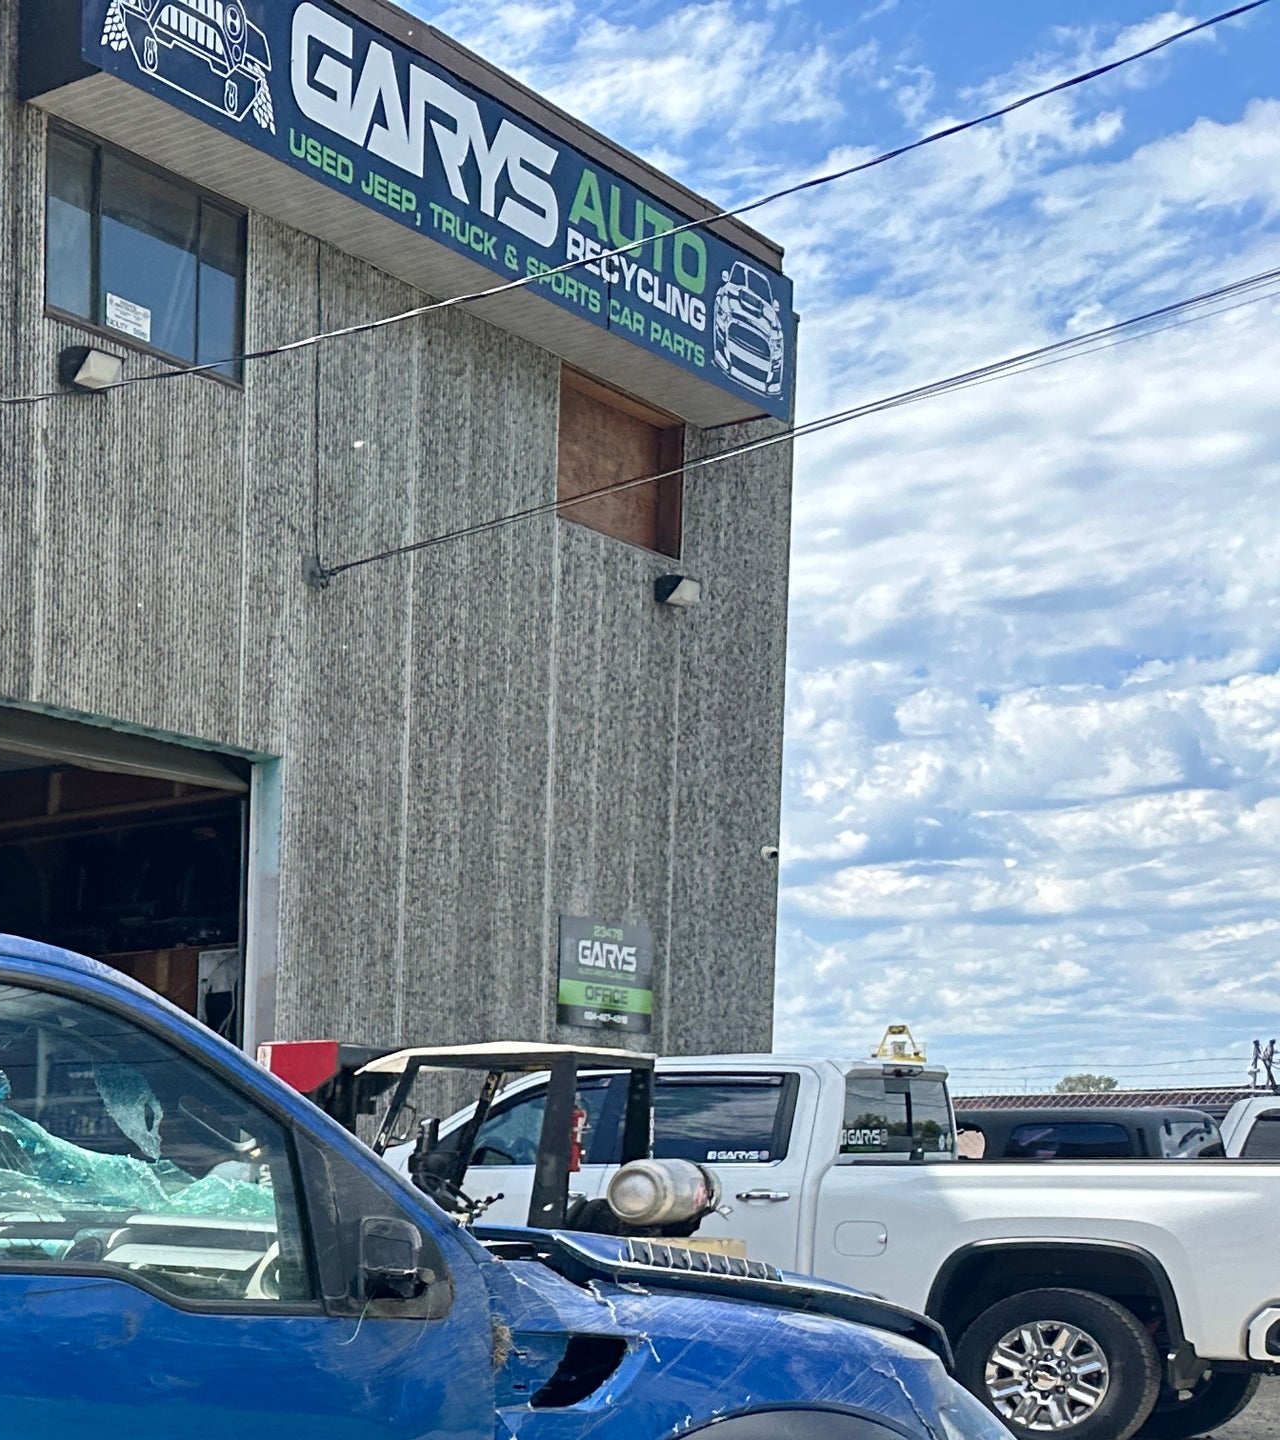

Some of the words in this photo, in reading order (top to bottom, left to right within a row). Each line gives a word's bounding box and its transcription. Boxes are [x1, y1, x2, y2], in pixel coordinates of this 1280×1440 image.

[291, 2, 559, 247] GARYS
[289, 128, 353, 184] USED
[361, 171, 421, 226] JEEP,
[429, 203, 497, 260] TRUCK
[504, 244, 518, 271] &
[526, 255, 601, 313] SPORTS
[608, 299, 645, 337] CAR
[650, 320, 705, 368] PARTS
[569, 168, 707, 295] AUTO
[567, 227, 706, 332] RECYCLING
[578, 940, 637, 972] GARYS
[585, 985, 628, 1005] OFFICE
[717, 1150, 759, 1160] GARYS
[847, 1129, 881, 1145] GARYS
